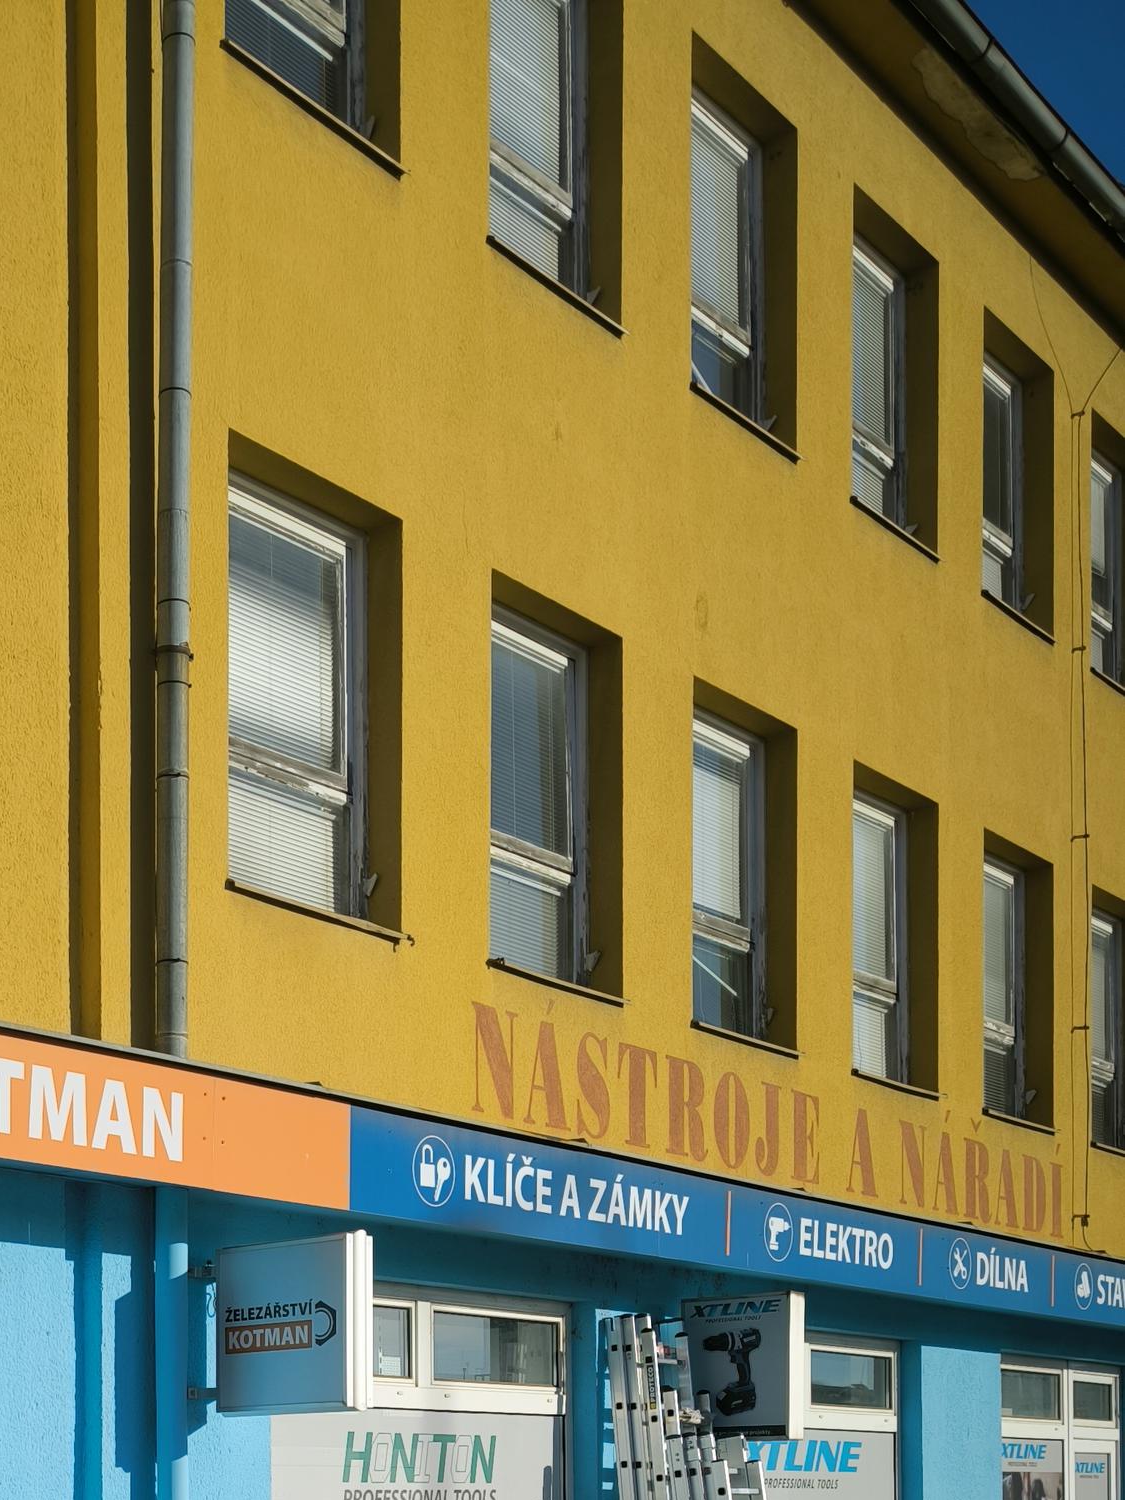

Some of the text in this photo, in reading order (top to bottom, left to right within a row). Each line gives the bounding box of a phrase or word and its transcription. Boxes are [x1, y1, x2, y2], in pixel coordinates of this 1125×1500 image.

[471, 1000, 1065, 1239] NÁSTROJE A NÁŘADÍ
[462, 1138, 690, 1236] KLÍČE A ZÁMKY
[799, 1217, 894, 1270] ELEKTRO
[976, 1246, 1029, 1294] DÍLNA
[1096, 1274, 1125, 1309] STA
[225, 1298, 313, 1323] ŽELEZÁŘSTVÍ
[690, 1299, 782, 1319] XTLINE
[228, 1324, 309, 1350] KOTMAN
[647, 1366, 656, 1402] PROTECO
[746, 1440, 863, 1473] XTLINE
[1002, 1443, 1047, 1460] XTLINE
[1075, 1462, 1106, 1473] XTLINE
[764, 1478, 839, 1490] PROFESSIONAL TOOLS
